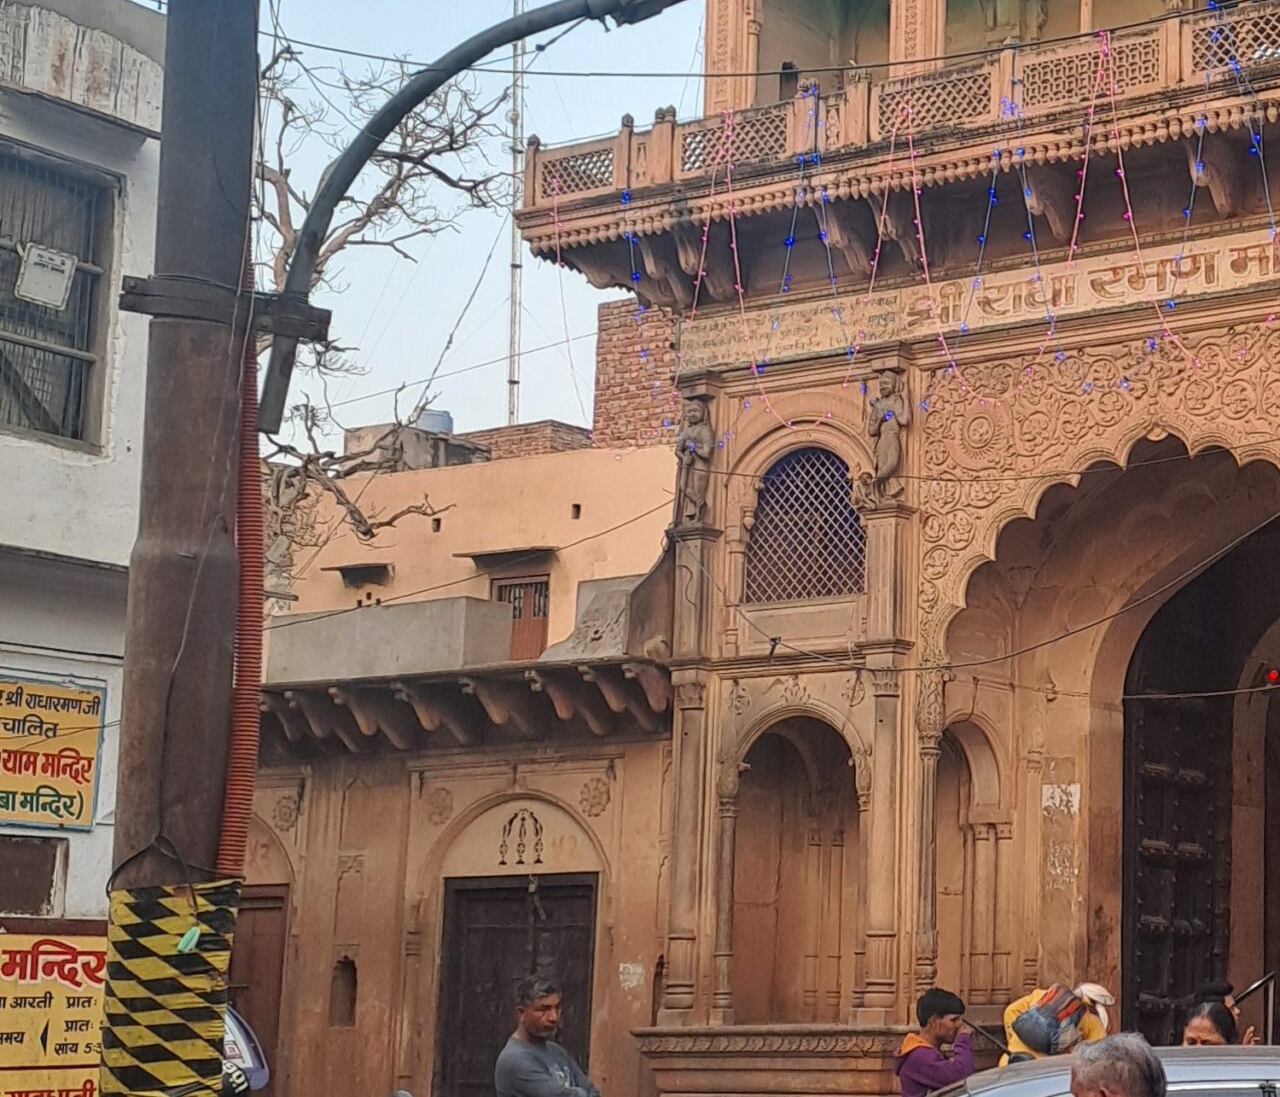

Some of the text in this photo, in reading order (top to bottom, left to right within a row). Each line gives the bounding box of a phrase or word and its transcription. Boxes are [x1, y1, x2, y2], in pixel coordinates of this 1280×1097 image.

[905, 280, 964, 329] श्री
[974, 275, 1078, 317] राधा
[1087, 251, 1221, 297] रमण
[5, 686, 24, 708] श्री
[41, 747, 95, 785] मन्दिर
[20, 784, 84, 820] मन्दिर)
[1, 939, 107, 987] मन्दिर
[10, 991, 54, 1009] आरती
